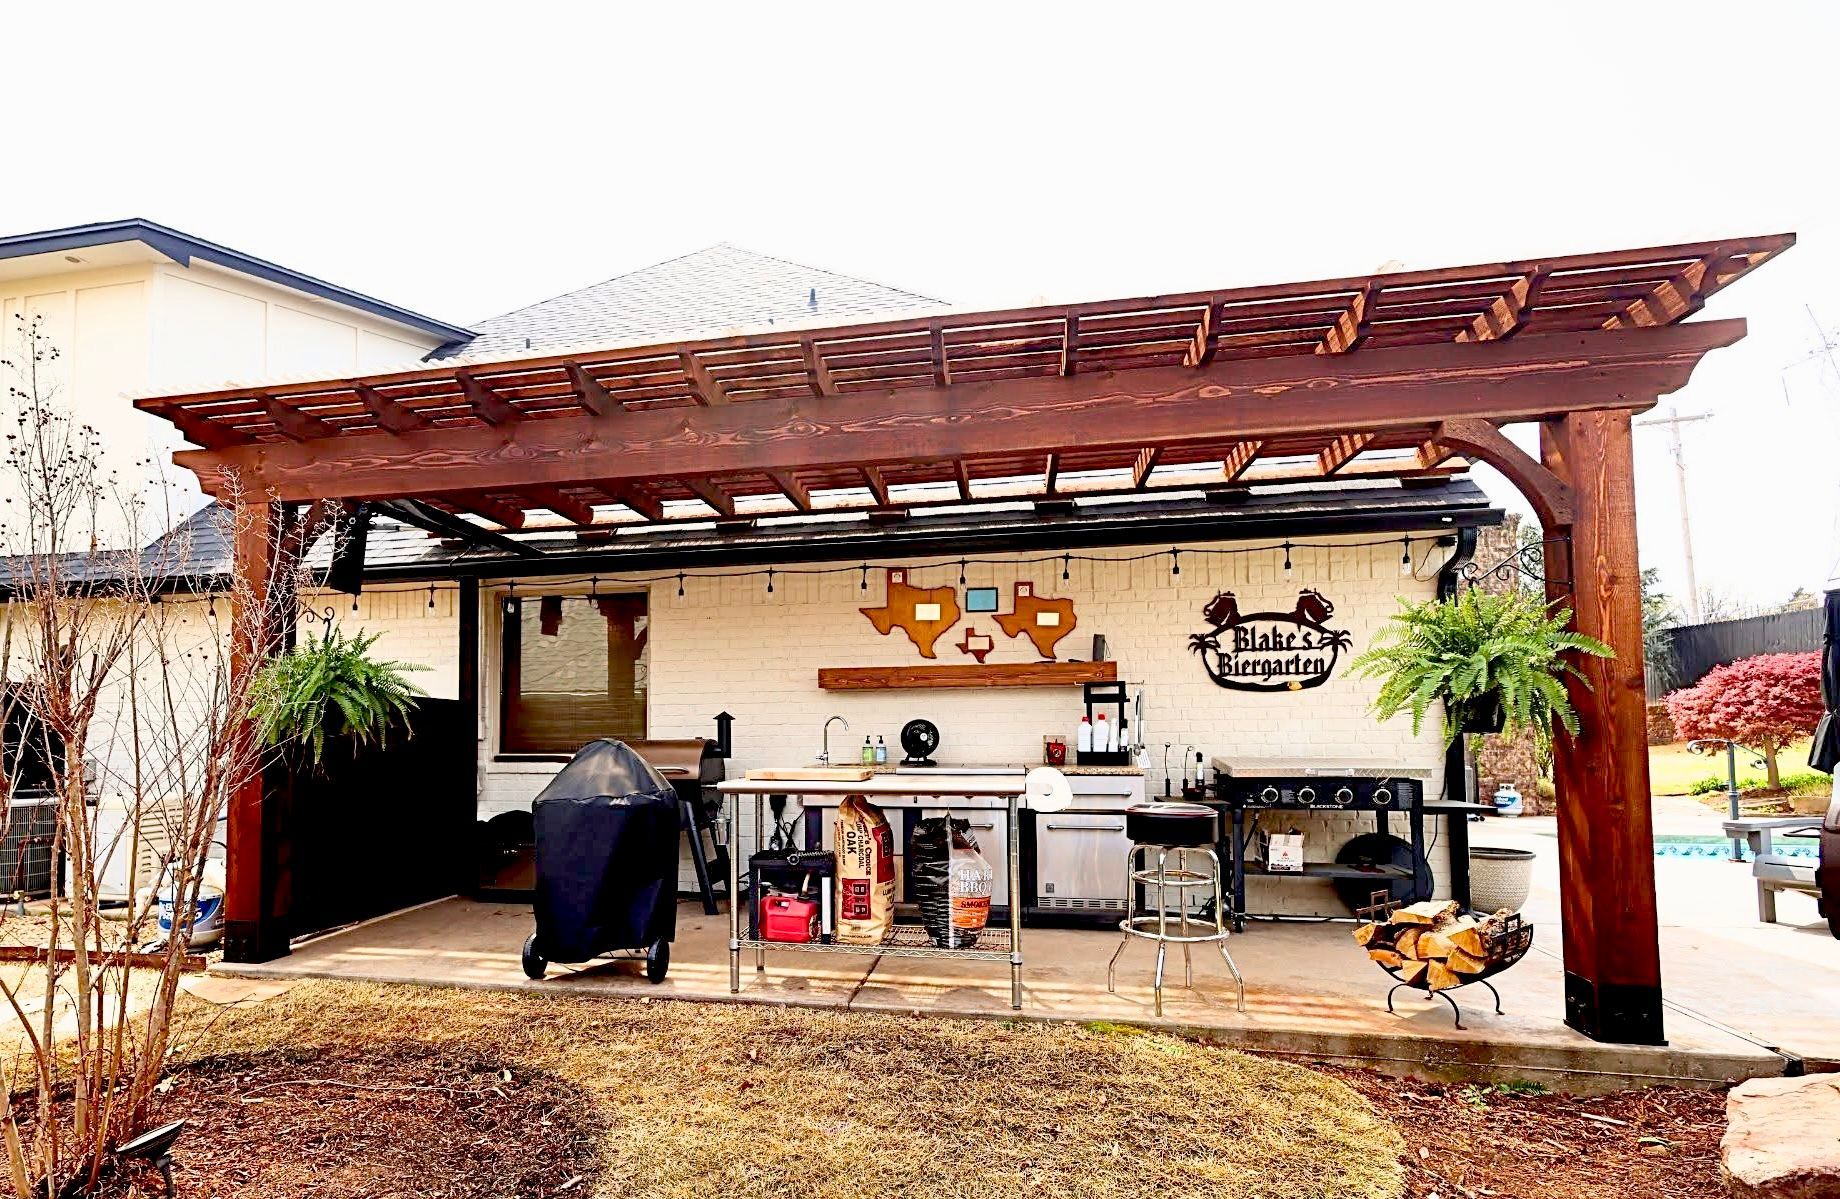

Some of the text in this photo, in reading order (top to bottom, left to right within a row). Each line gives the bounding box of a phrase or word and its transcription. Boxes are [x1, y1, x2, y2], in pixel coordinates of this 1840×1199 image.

[1233, 625, 1313, 652] Blake's
[1217, 652, 1325, 682] Biergarten
[846, 831, 857, 855] OAK
[857, 835, 865, 869] CHARCOAL
[959, 881, 987, 896] BBQ
